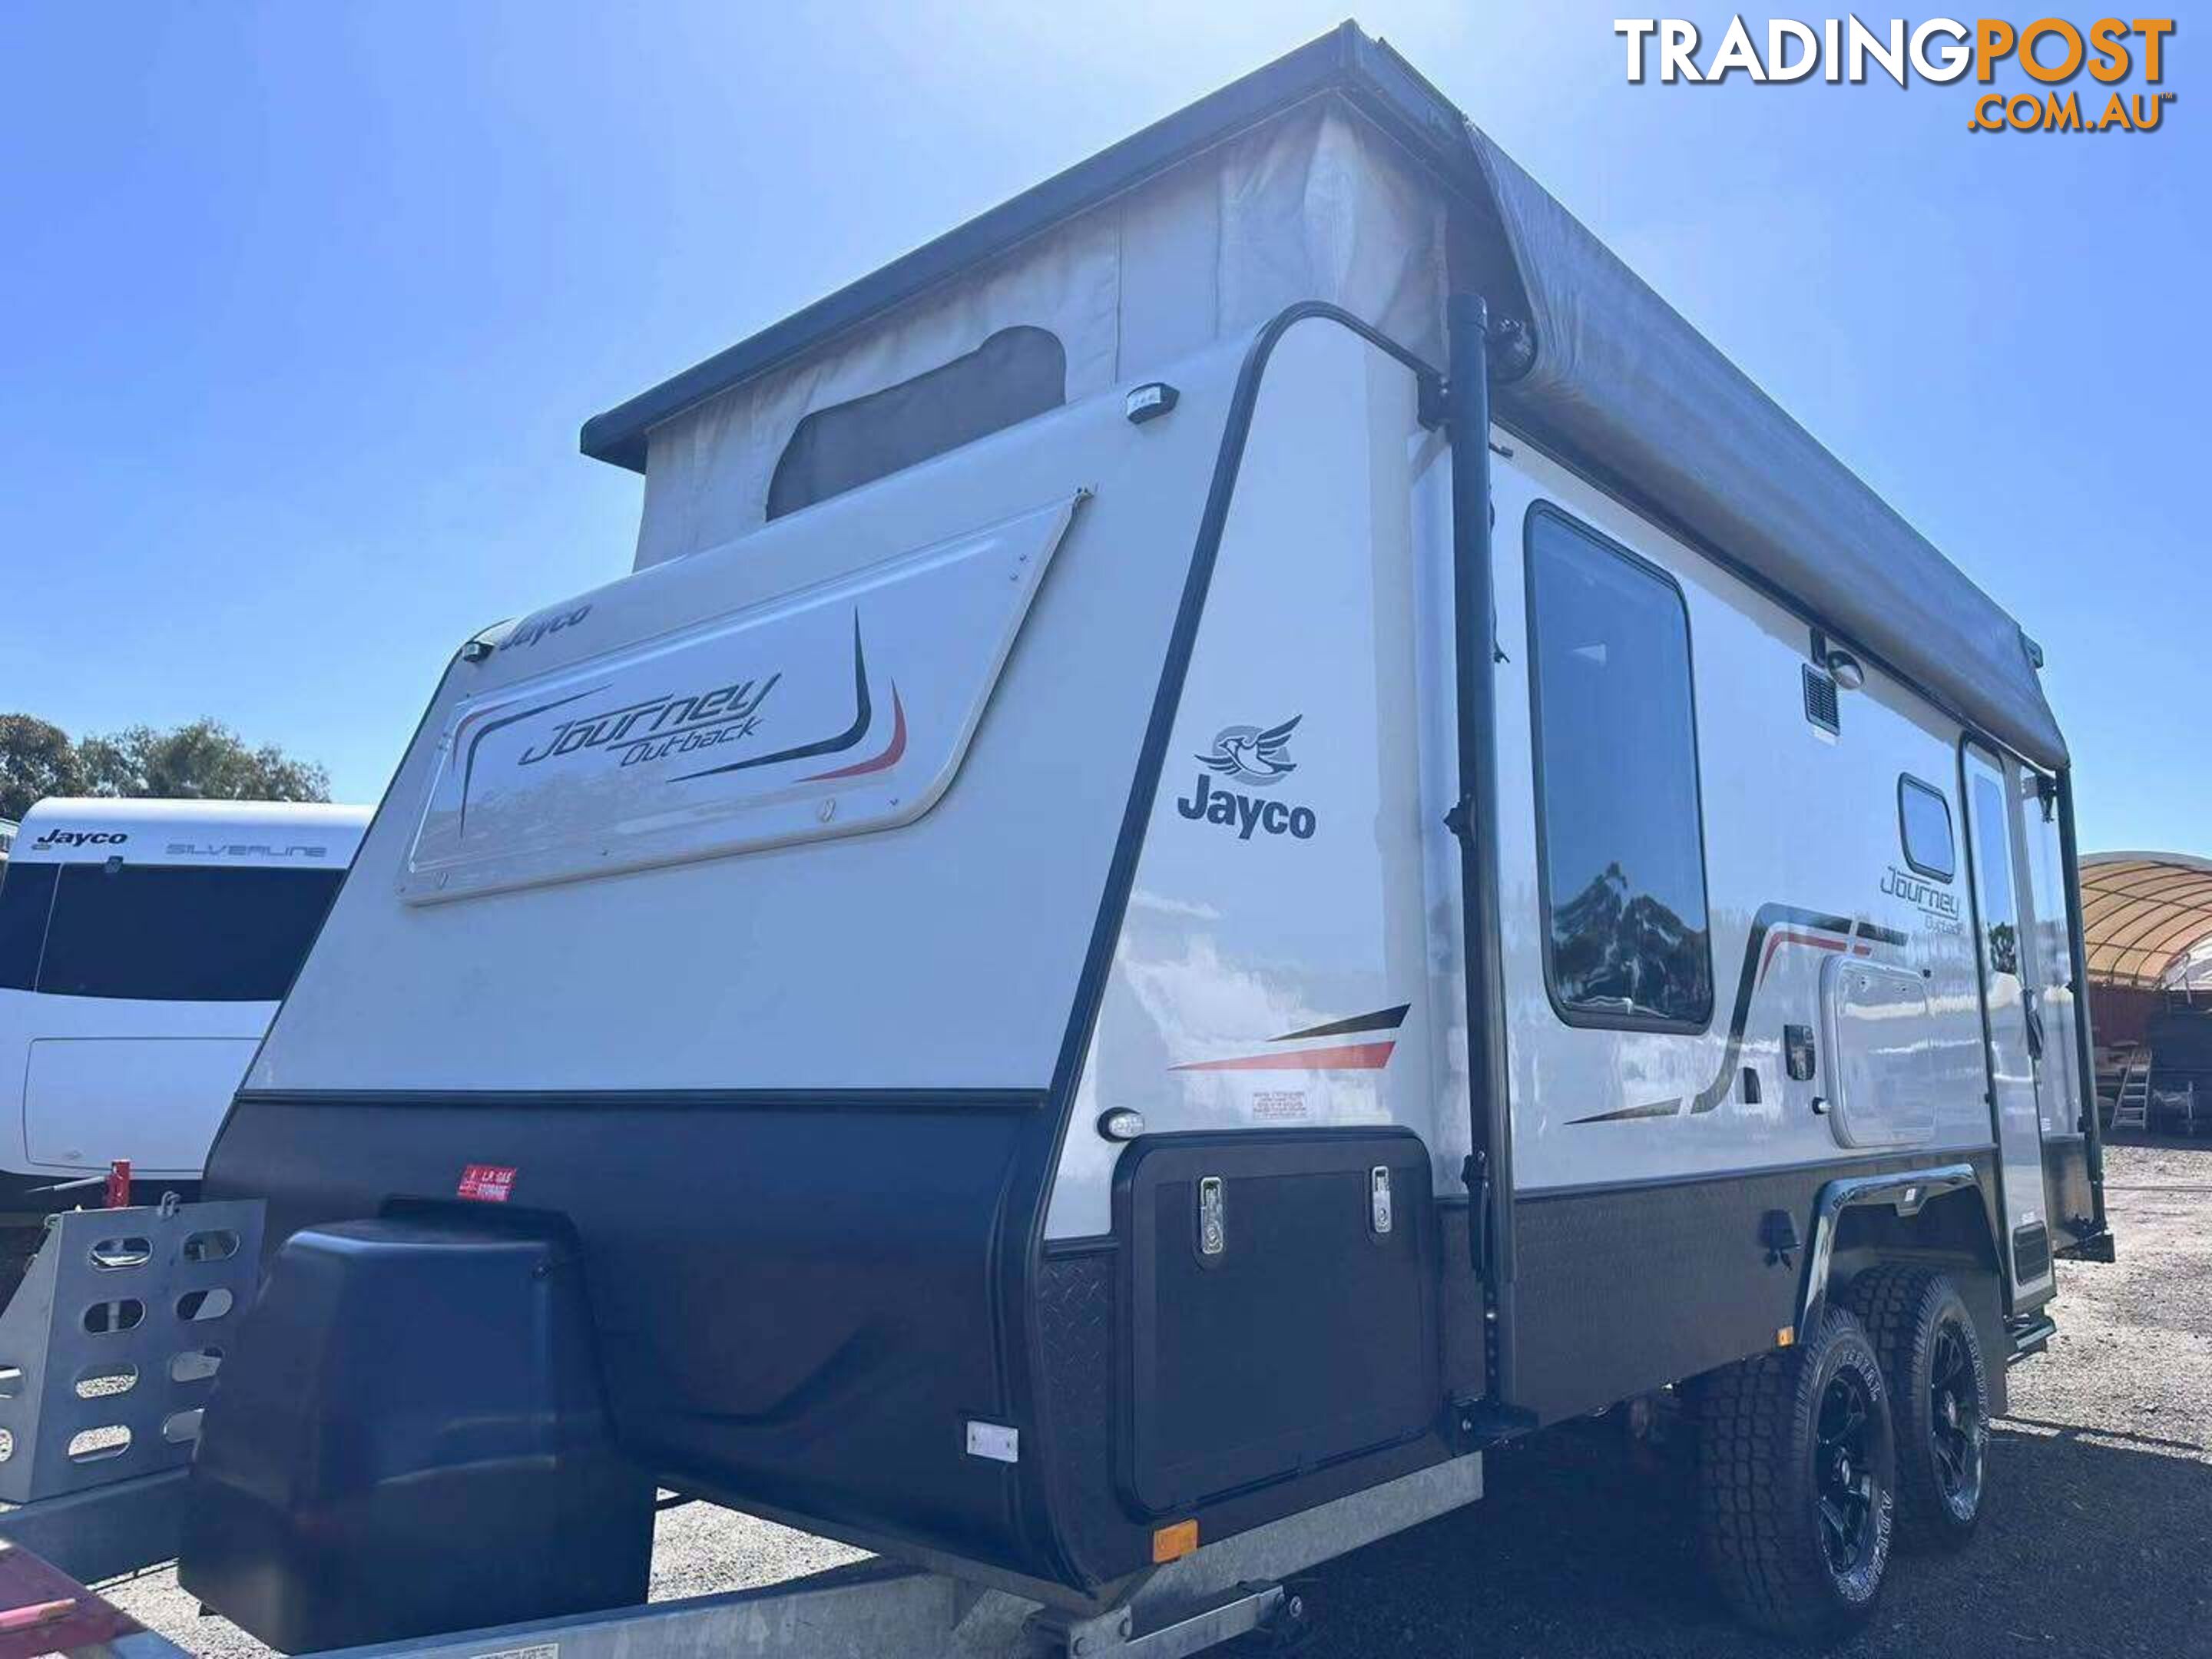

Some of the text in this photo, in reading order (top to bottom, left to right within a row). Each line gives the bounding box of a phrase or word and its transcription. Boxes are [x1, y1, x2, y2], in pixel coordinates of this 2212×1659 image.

[518, 673, 781, 766] Journey
[621, 717, 763, 767] Outback
[1177, 773, 1316, 839] Jayco
[37, 829, 128, 846] Jayco
[165, 843, 326, 858] SILVERLINE
[1880, 866, 1960, 921] Journey
